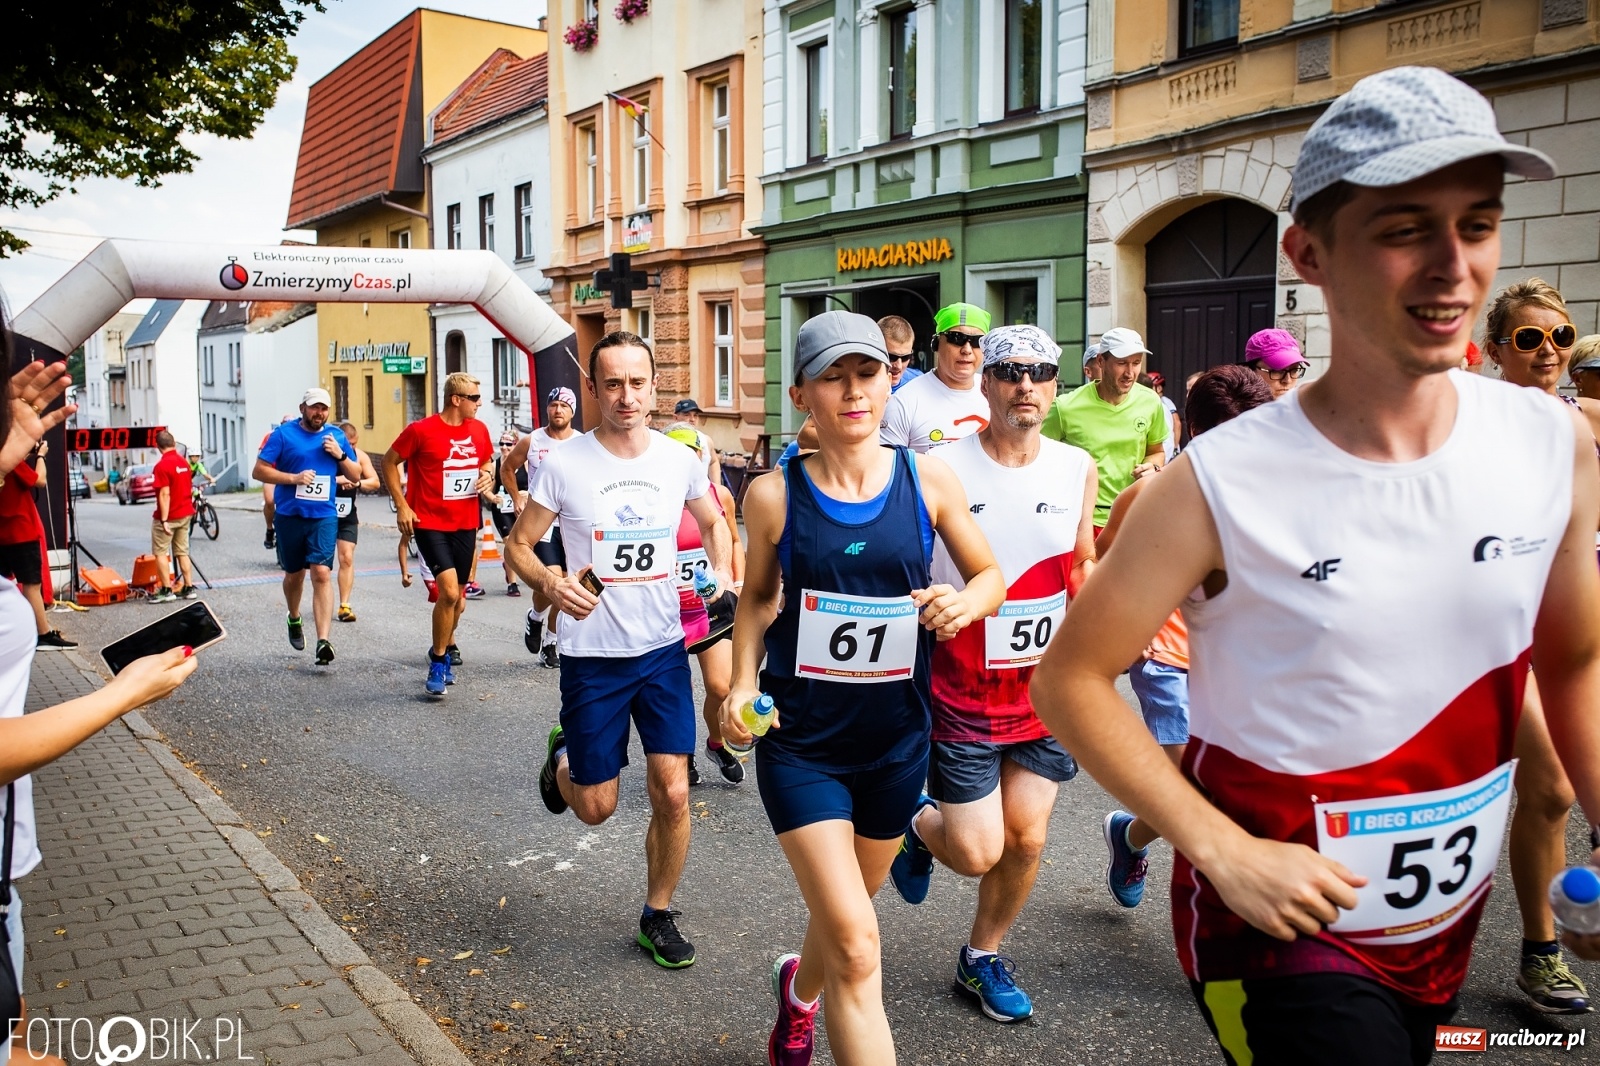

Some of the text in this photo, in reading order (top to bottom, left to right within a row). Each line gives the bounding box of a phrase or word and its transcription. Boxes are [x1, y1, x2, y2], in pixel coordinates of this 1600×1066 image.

[253, 252, 404, 265] Elektroniczny pomiar czasu
[837, 237, 953, 272] KWIACIARNIA
[252, 270, 411, 292] ZmierzymyCzas.pl
[1286, 289, 1297, 311] 5
[305, 483, 323, 495] 55
[453, 478, 471, 492] 57
[603, 482, 618, 493] BIEG
[618, 480, 660, 493] KRZANOWICKI
[335, 503, 346, 513] 8
[969, 503, 986, 514] 4F
[625, 530, 669, 539] KRZANOWICKI
[844, 541, 866, 555] 4F
[613, 543, 655, 573] 58
[1300, 558, 1341, 582] 4F
[819, 601, 914, 616] I BIEG KRZANOWICKI
[1005, 607, 1022, 615] BIEG
[1023, 600, 1063, 614] KRZANOWICKI
[1009, 616, 1052, 652] 50
[829, 621, 888, 663] 61
[1354, 777, 1508, 831] I BIEG KRZANOWICKI
[1384, 825, 1478, 910] 53
